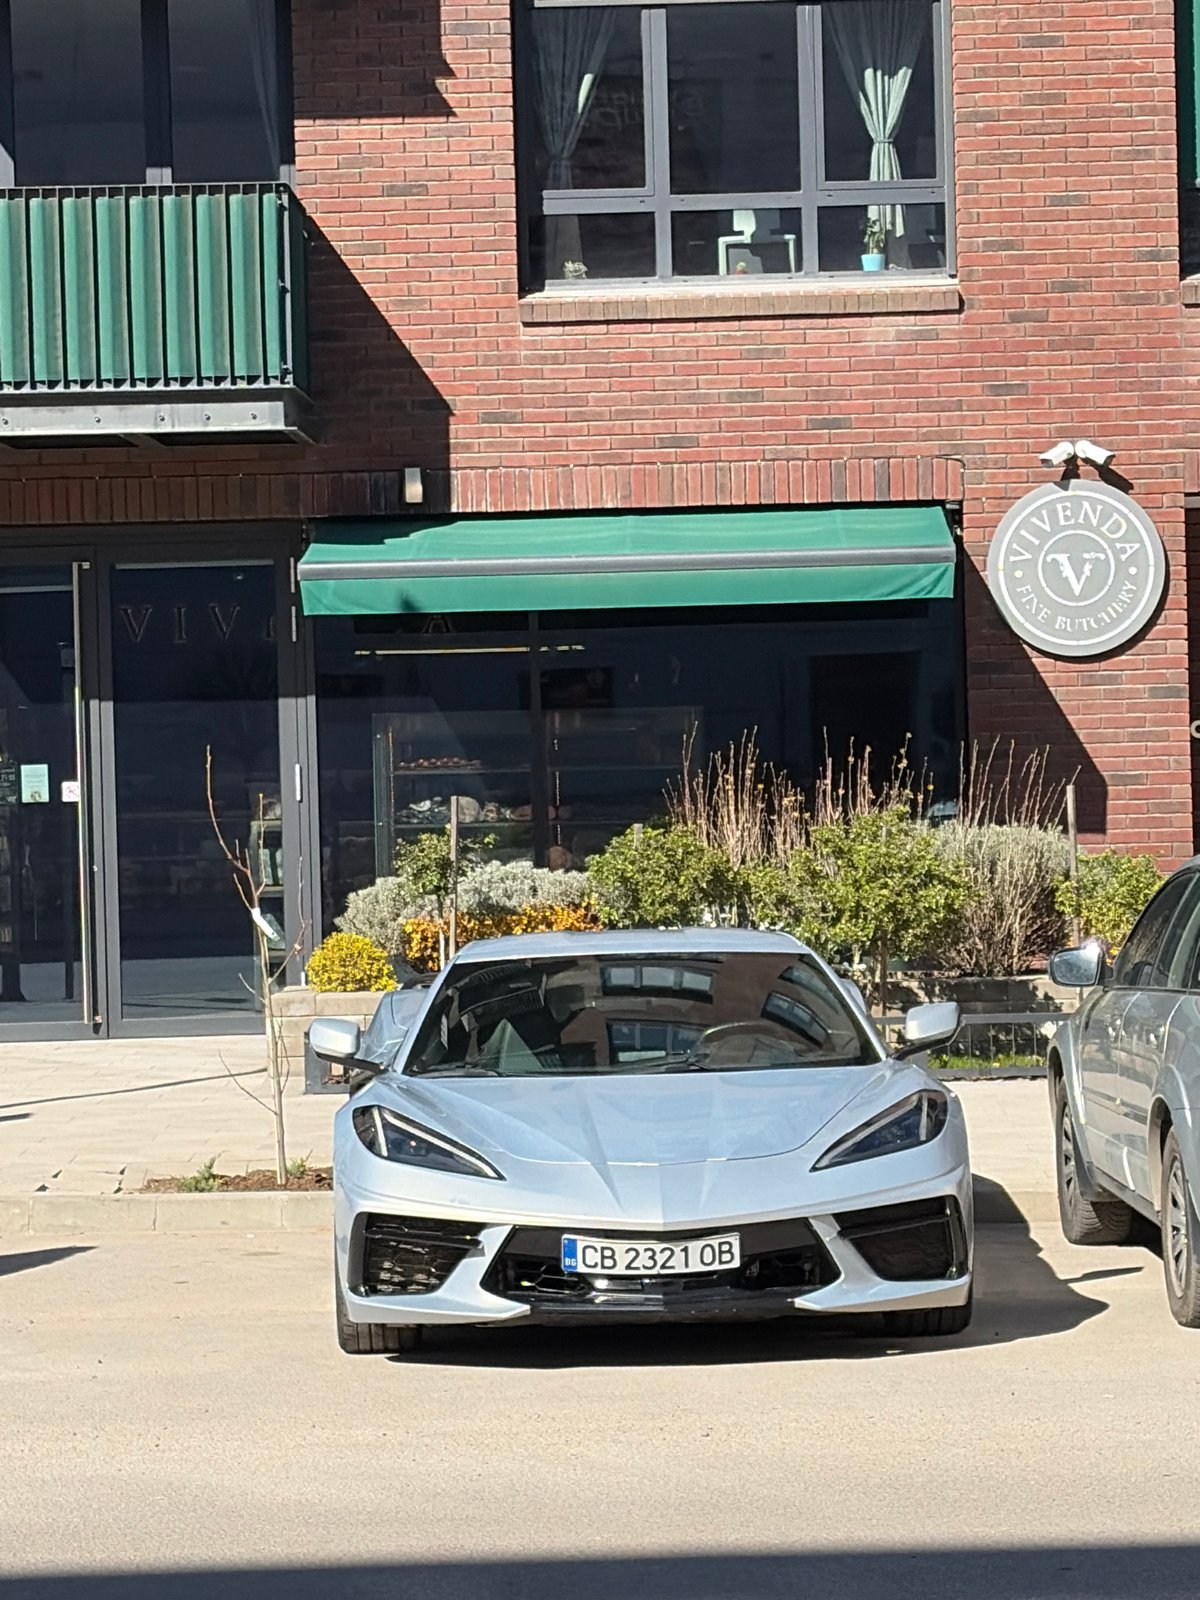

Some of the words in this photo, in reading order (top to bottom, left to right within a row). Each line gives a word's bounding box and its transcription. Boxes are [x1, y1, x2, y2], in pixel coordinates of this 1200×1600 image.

[1009, 501, 1141, 564] VIVENDA
[1046, 552, 1105, 597] V
[1016, 584, 1052, 623] FINE
[1055, 580, 1137, 632] BUTCHERY
[582, 1244, 617, 1270] CB
[624, 1246, 690, 1271] 2321
[699, 1241, 735, 1267] OB
